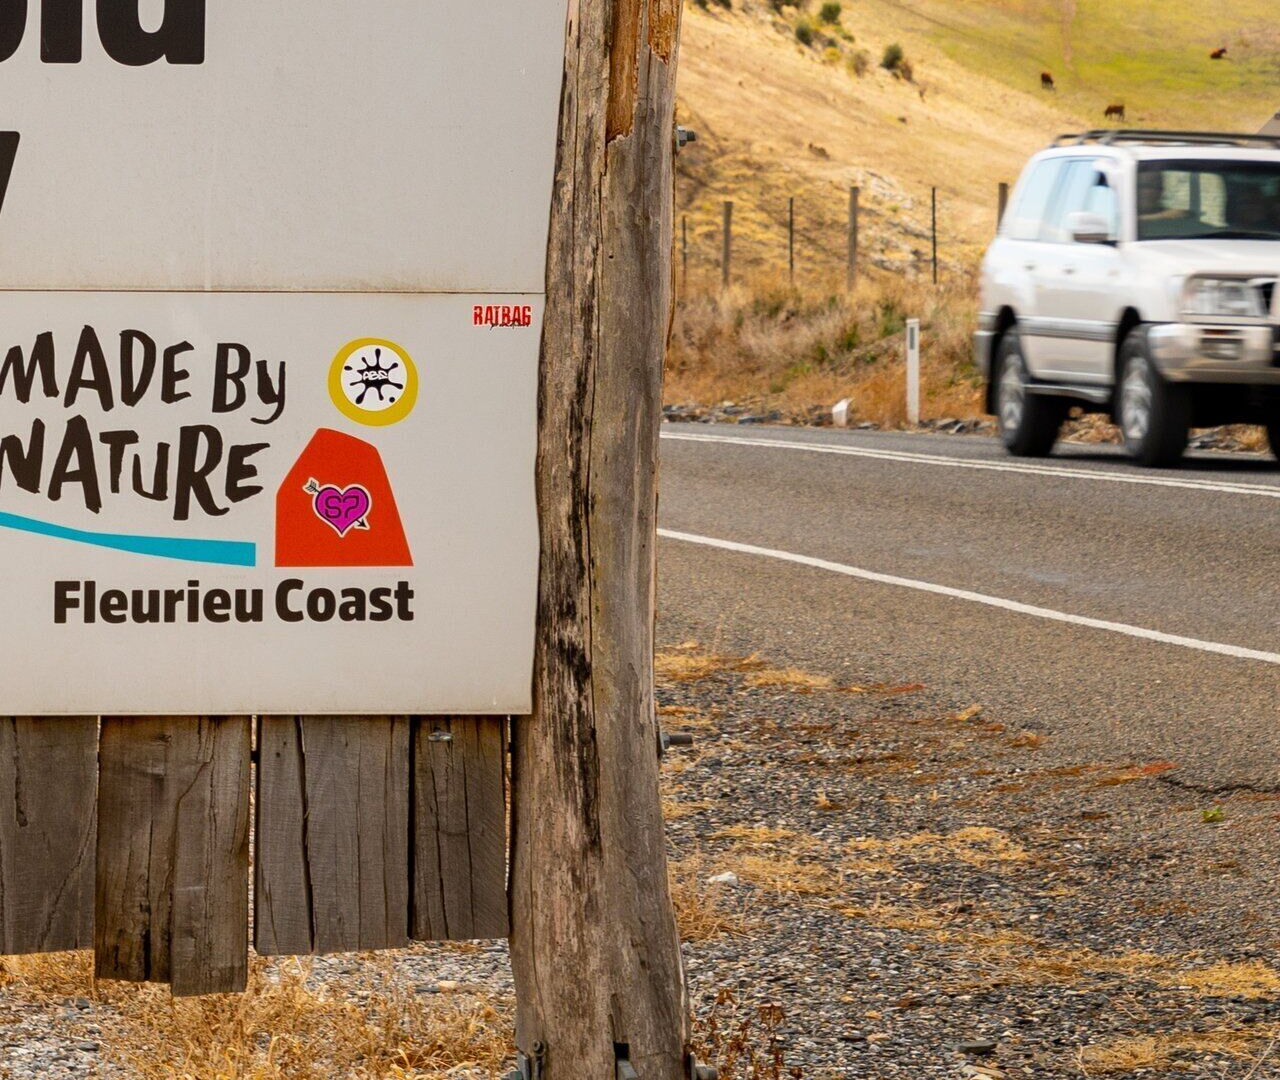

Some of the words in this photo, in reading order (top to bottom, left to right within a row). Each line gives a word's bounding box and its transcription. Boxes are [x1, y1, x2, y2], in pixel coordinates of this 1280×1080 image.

[473, 305, 532, 326] RATBAG
[211, 342, 286, 425] By
[54, 580, 264, 624] Fleurieu
[275, 579, 415, 623] Coast
